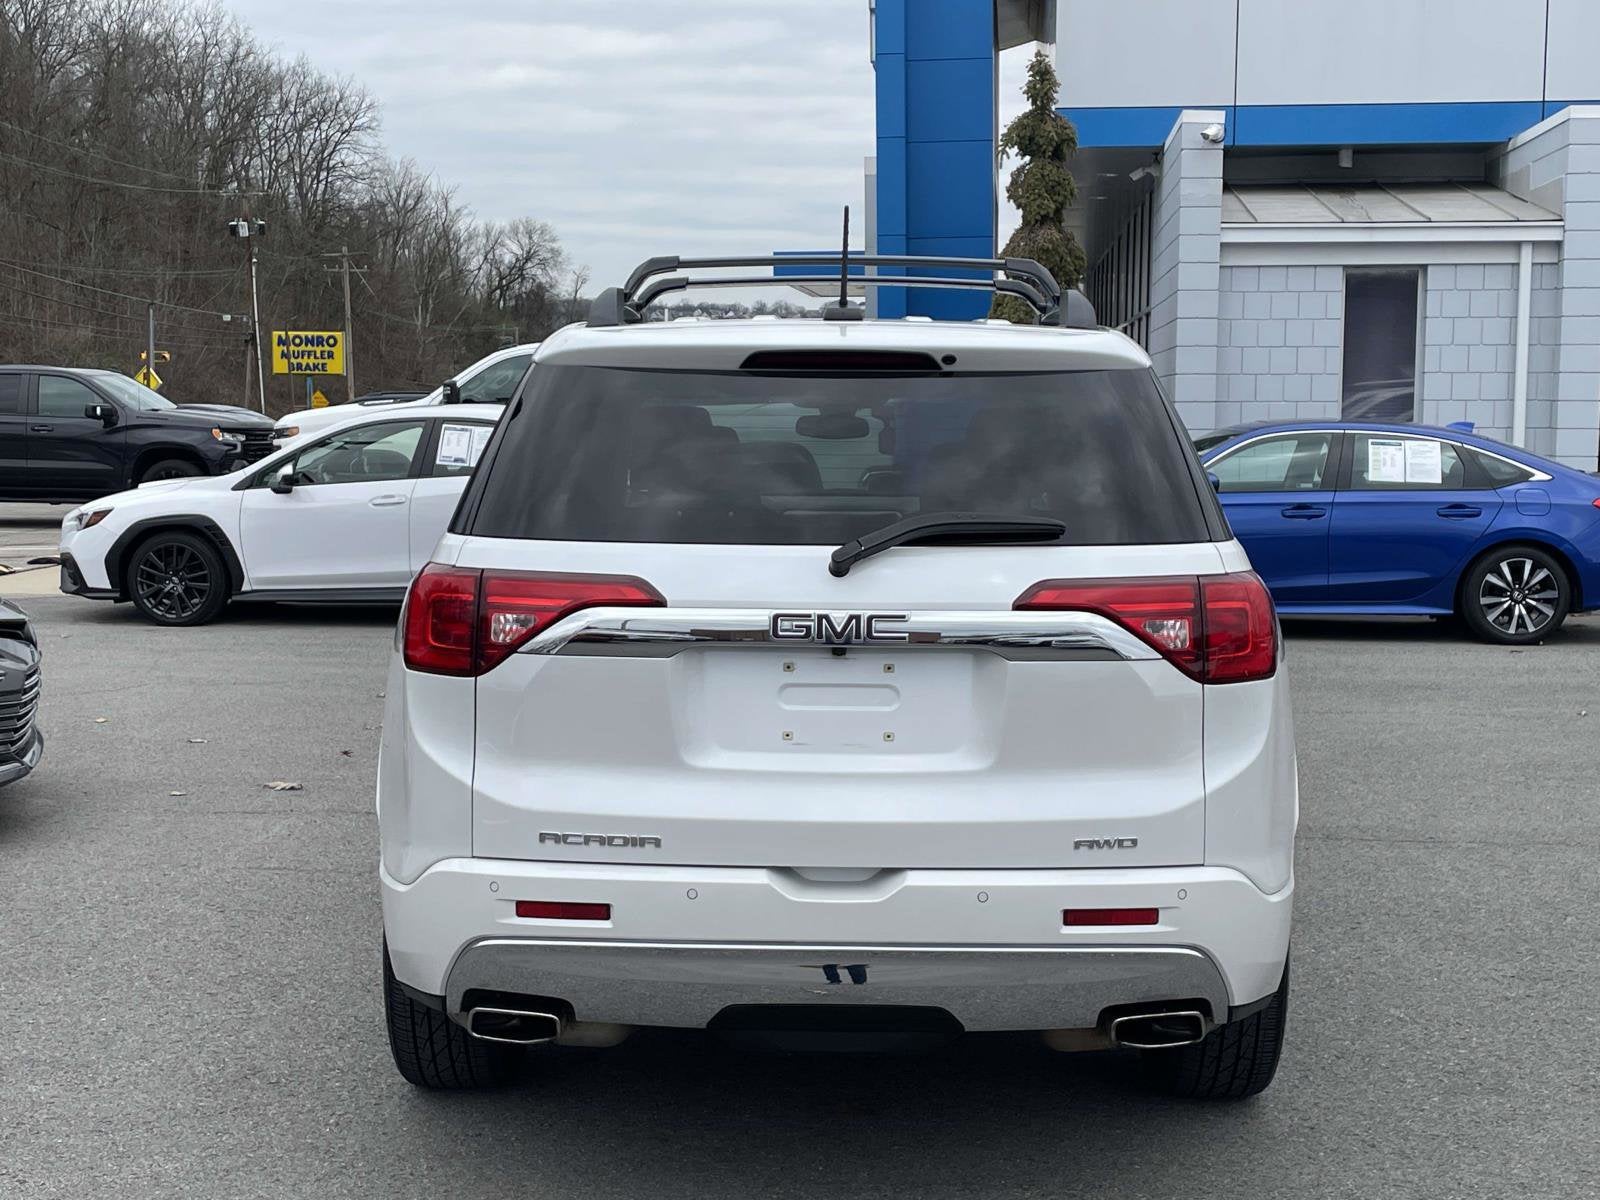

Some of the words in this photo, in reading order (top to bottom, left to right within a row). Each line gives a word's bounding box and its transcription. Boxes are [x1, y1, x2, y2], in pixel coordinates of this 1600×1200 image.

[277, 334, 338, 348] MONRO
[769, 611, 911, 643] GMC
[538, 831, 662, 848] ACADIA
[1073, 837, 1138, 850] AWD
